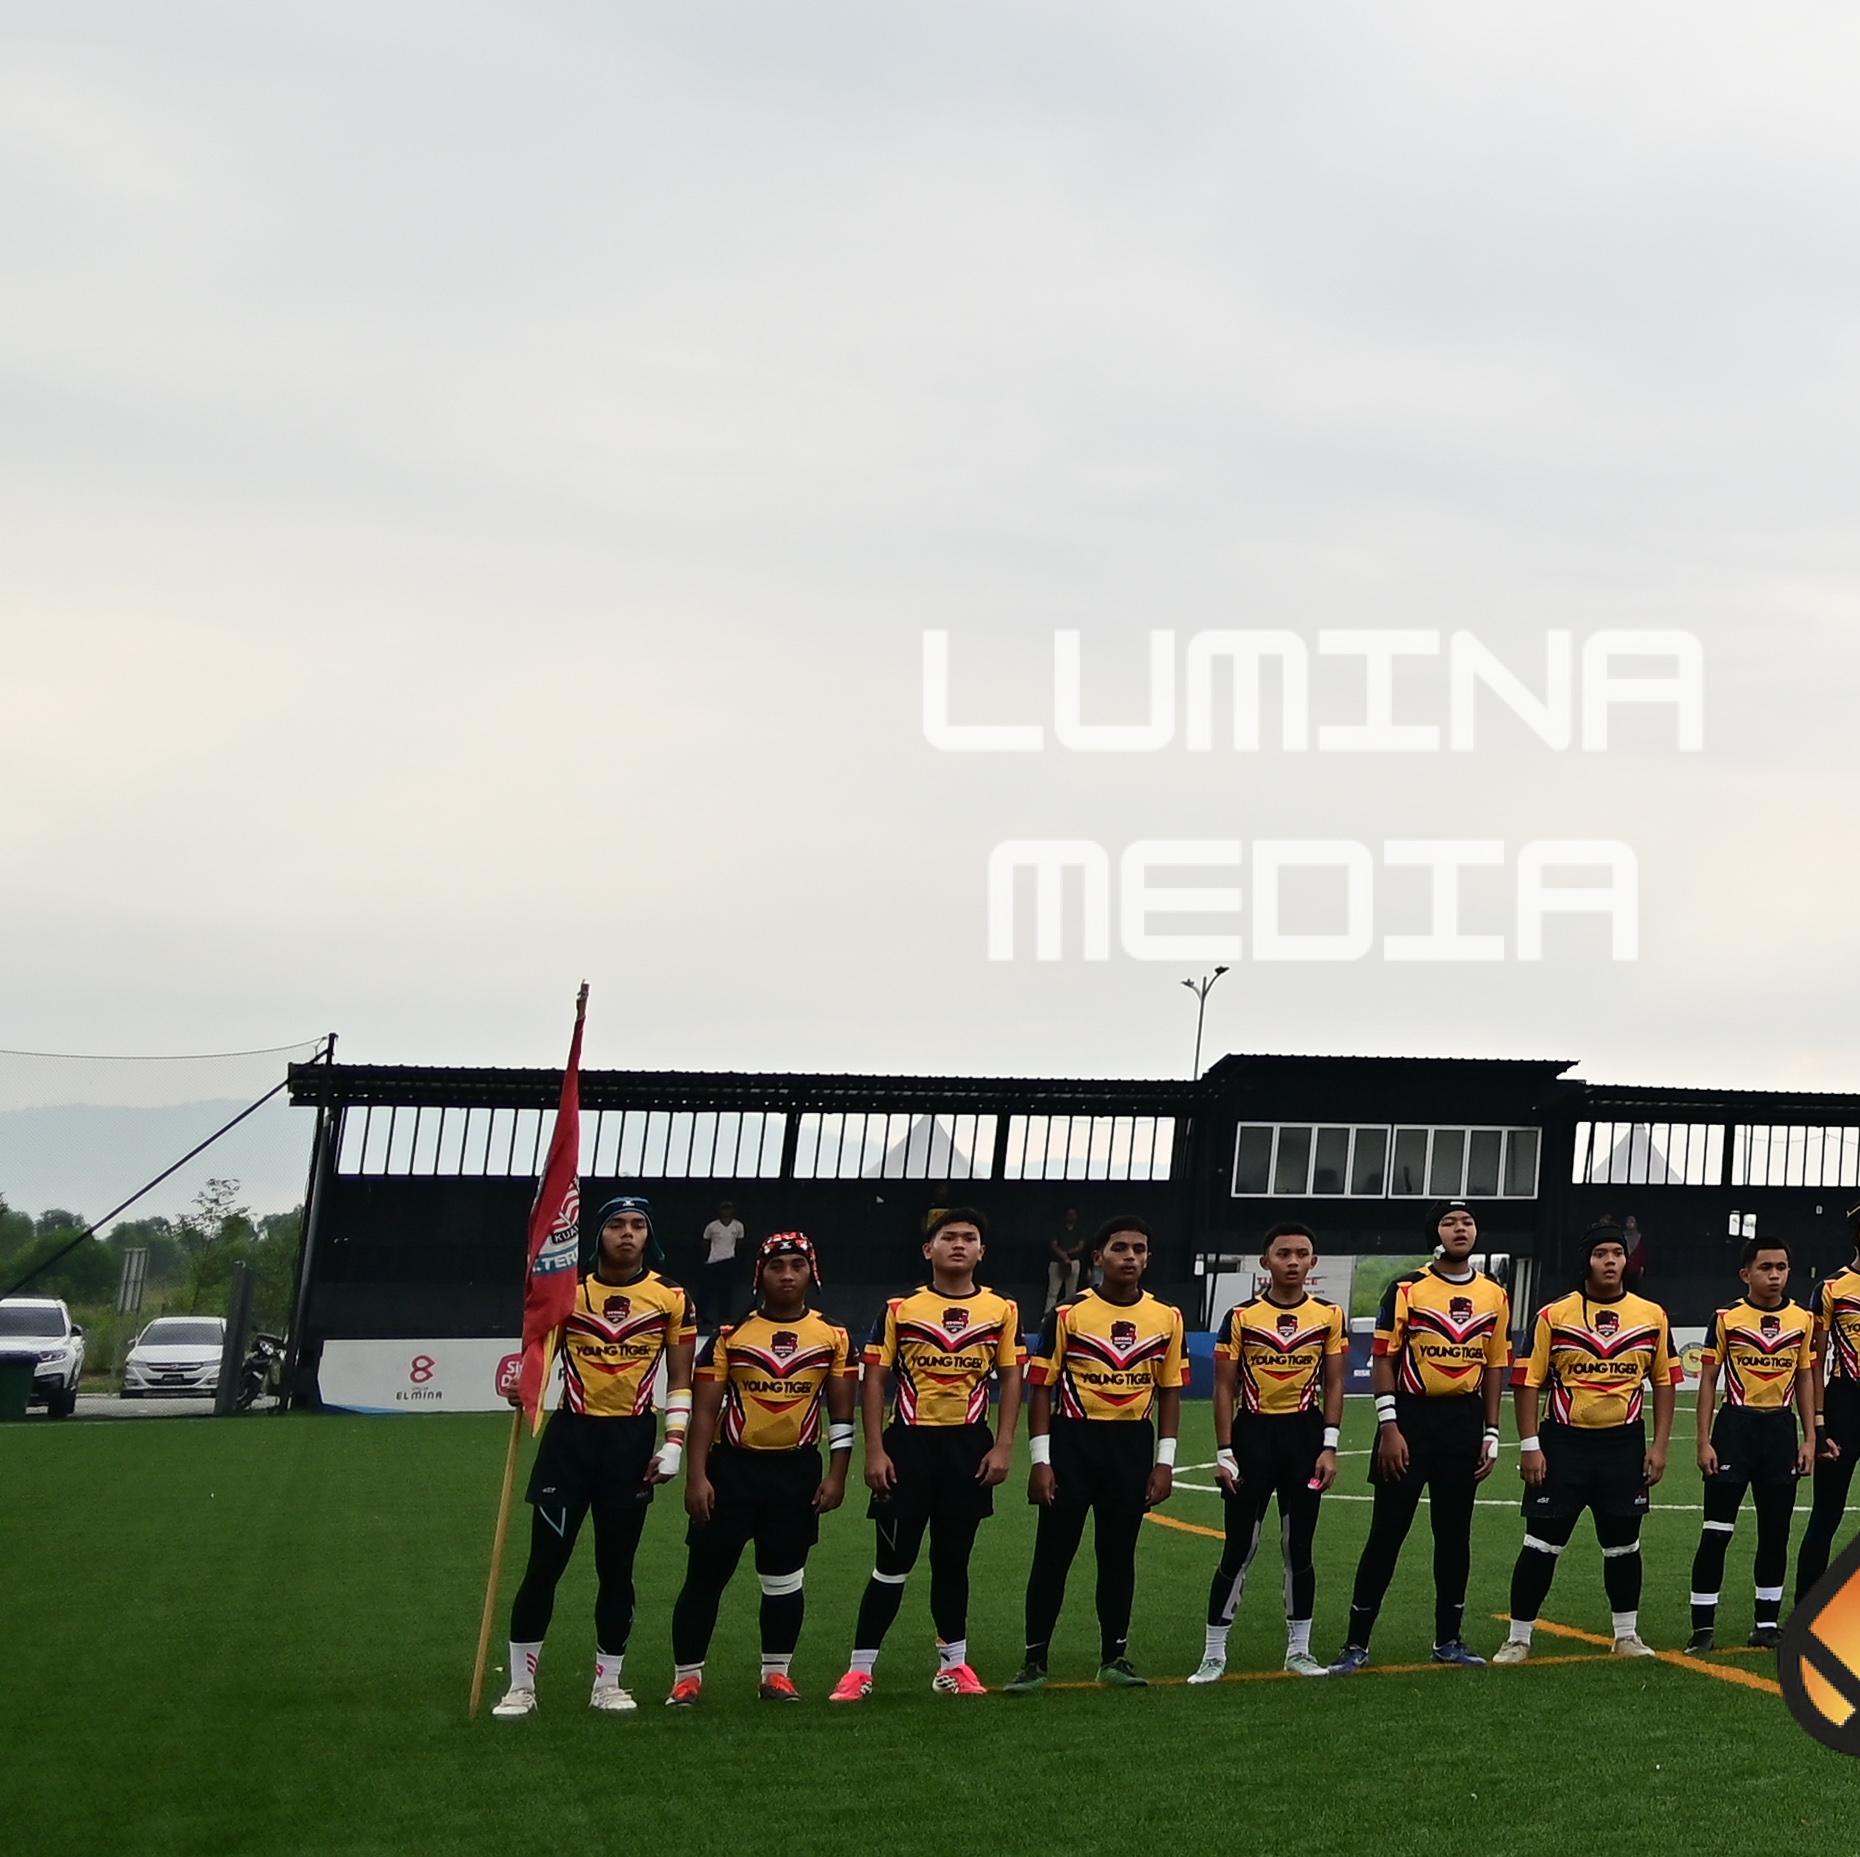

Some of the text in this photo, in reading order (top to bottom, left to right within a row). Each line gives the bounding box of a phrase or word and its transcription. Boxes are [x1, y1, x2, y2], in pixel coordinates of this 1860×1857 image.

[576, 1345, 617, 1356] YOUNG
[1420, 1345, 1460, 1357] YOUNG
[911, 1356, 952, 1368] YOUNG
[1250, 1355, 1287, 1366] YOUNG
[1737, 1356, 1772, 1368] YOUNG
[1568, 1363, 1608, 1375] YOUNG
[1082, 1372, 1123, 1385] YOUNG
[742, 1379, 784, 1393] YOUNG
[396, 1389, 443, 1401] ELMINA
